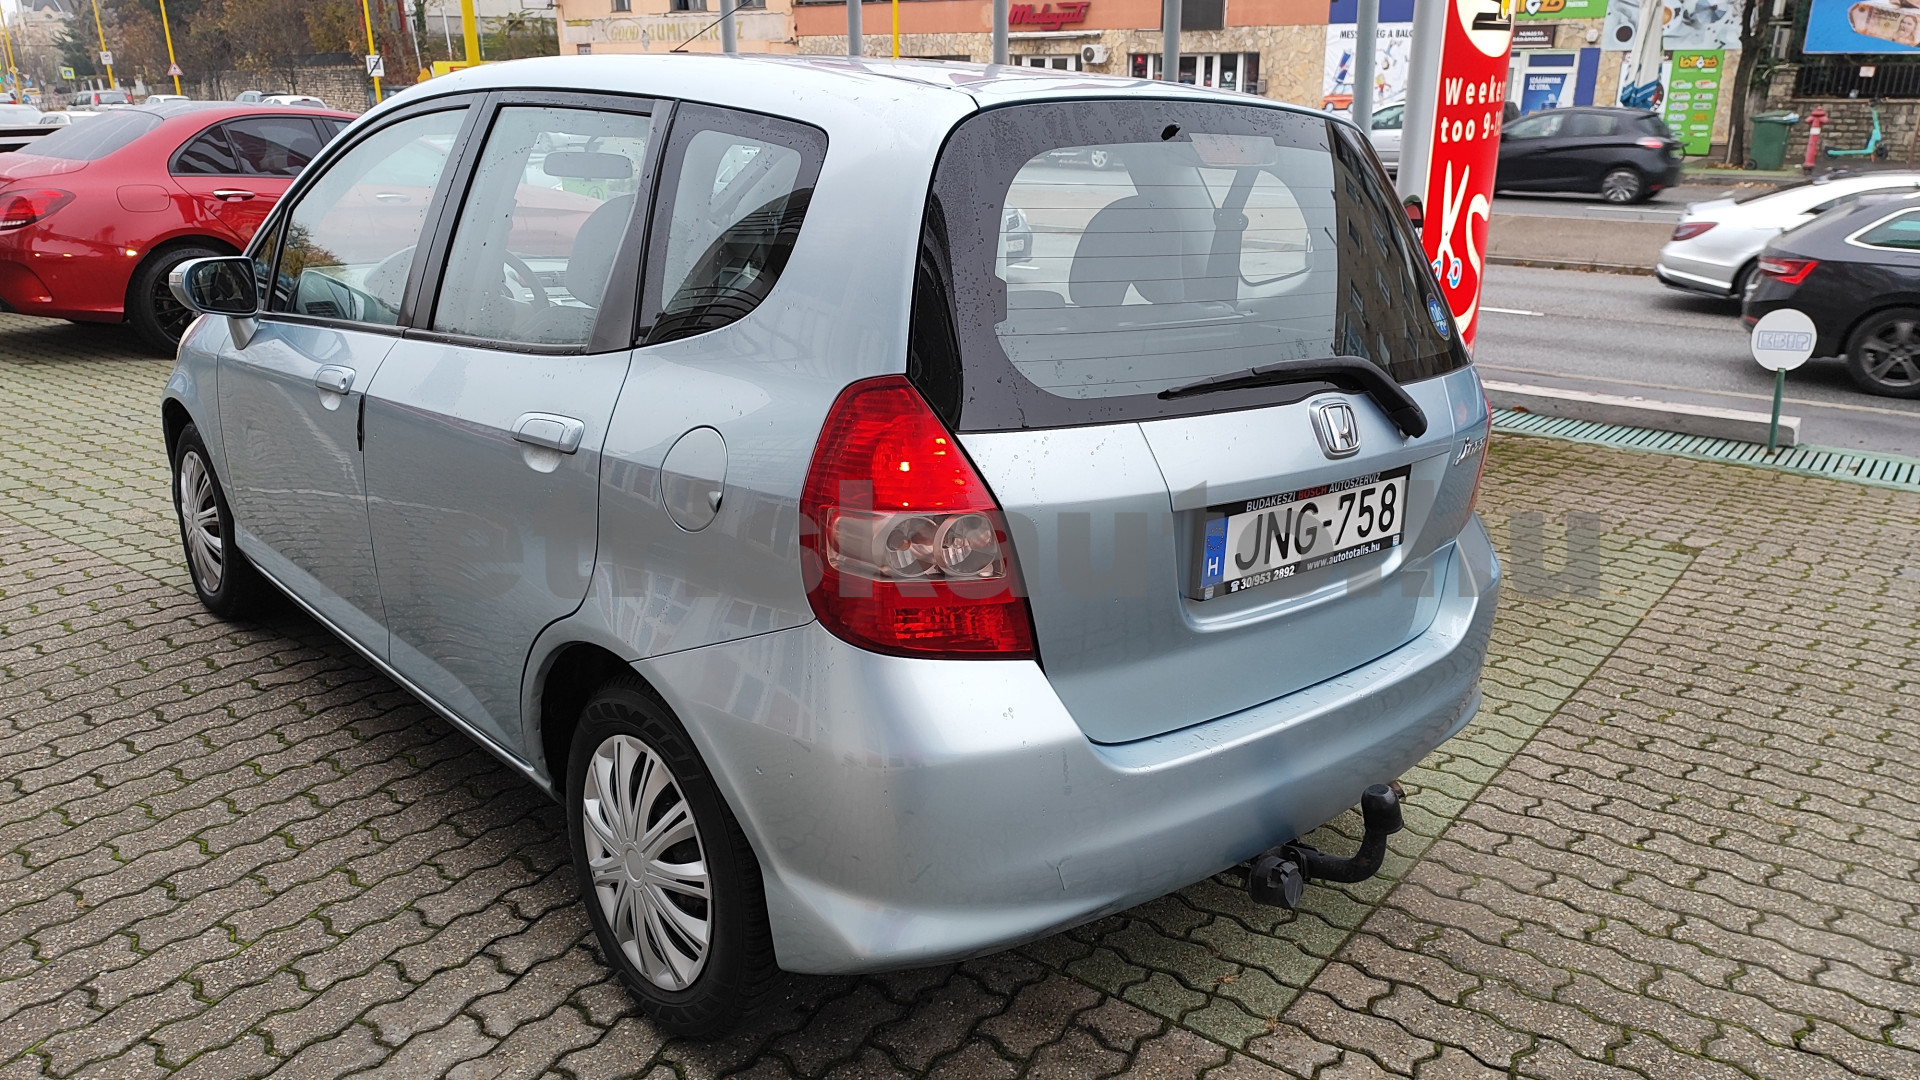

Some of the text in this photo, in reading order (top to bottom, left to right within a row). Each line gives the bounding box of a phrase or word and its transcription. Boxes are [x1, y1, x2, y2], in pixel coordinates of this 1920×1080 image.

[1008, 2, 1091, 30] Malaguti
[611, 22, 744, 40] GOOD GUMISZERZ
[1440, 117, 1475, 143] too
[1246, 472, 1381, 512] BUDAKESZI BOSCH AUTOSZERVIZ
[1235, 483, 1397, 571] JNG-758
[1207, 556, 1219, 577] H
[1306, 542, 1381, 571] www.autototalis.hu
[1240, 565, 1295, 590] 30/953 2892
